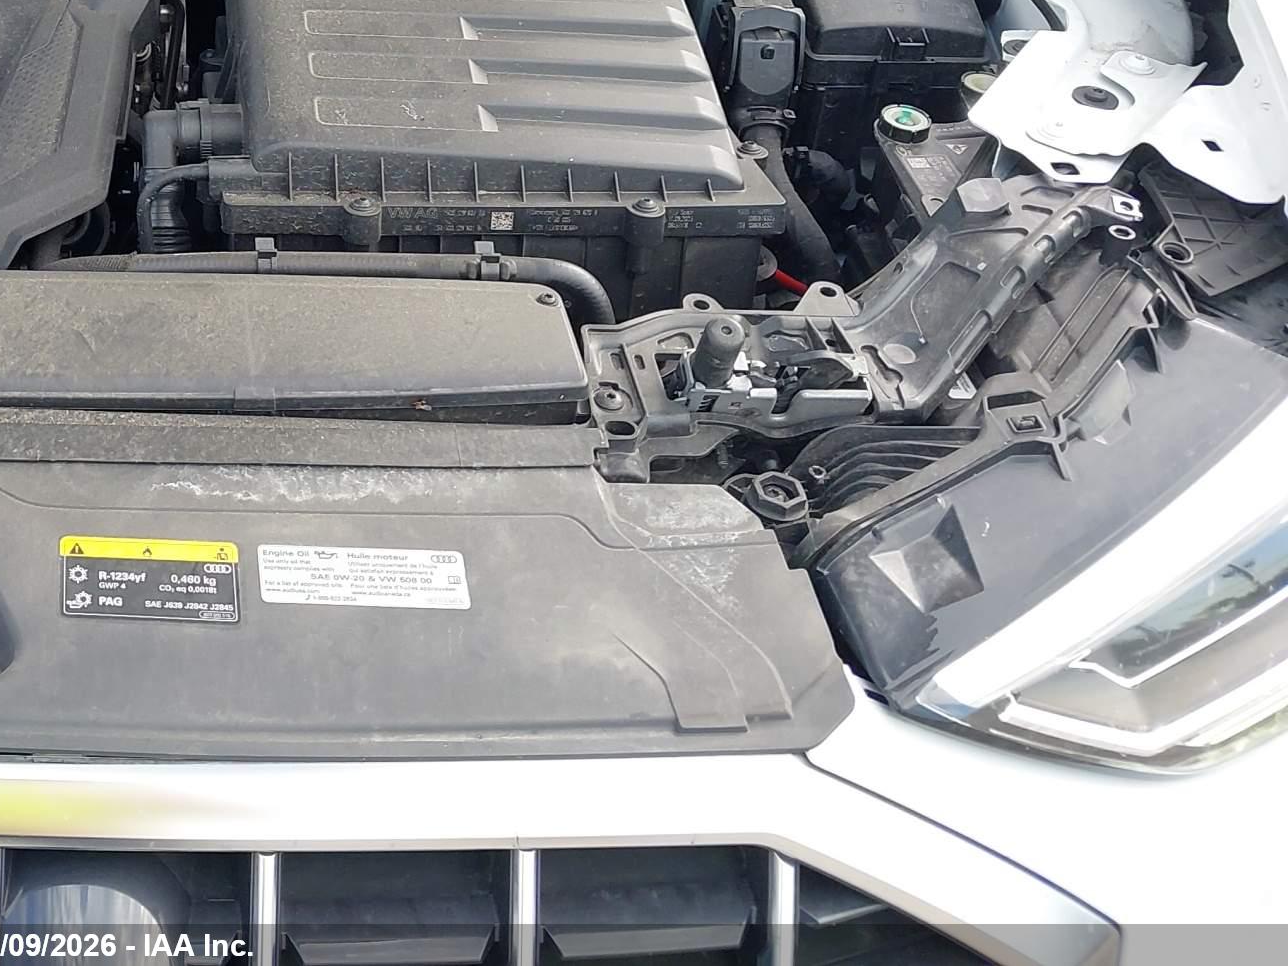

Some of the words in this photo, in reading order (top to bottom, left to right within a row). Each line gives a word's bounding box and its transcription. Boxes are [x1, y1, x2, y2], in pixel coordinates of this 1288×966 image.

[263, 549, 294, 557] Engine
[347, 552, 371, 560] Huile
[98, 570, 146, 583] R-1234yf
[203, 575, 216, 586] kg
[99, 582, 119, 590] GWP
[98, 596, 123, 607] PAG
[145, 600, 162, 608] SAE
